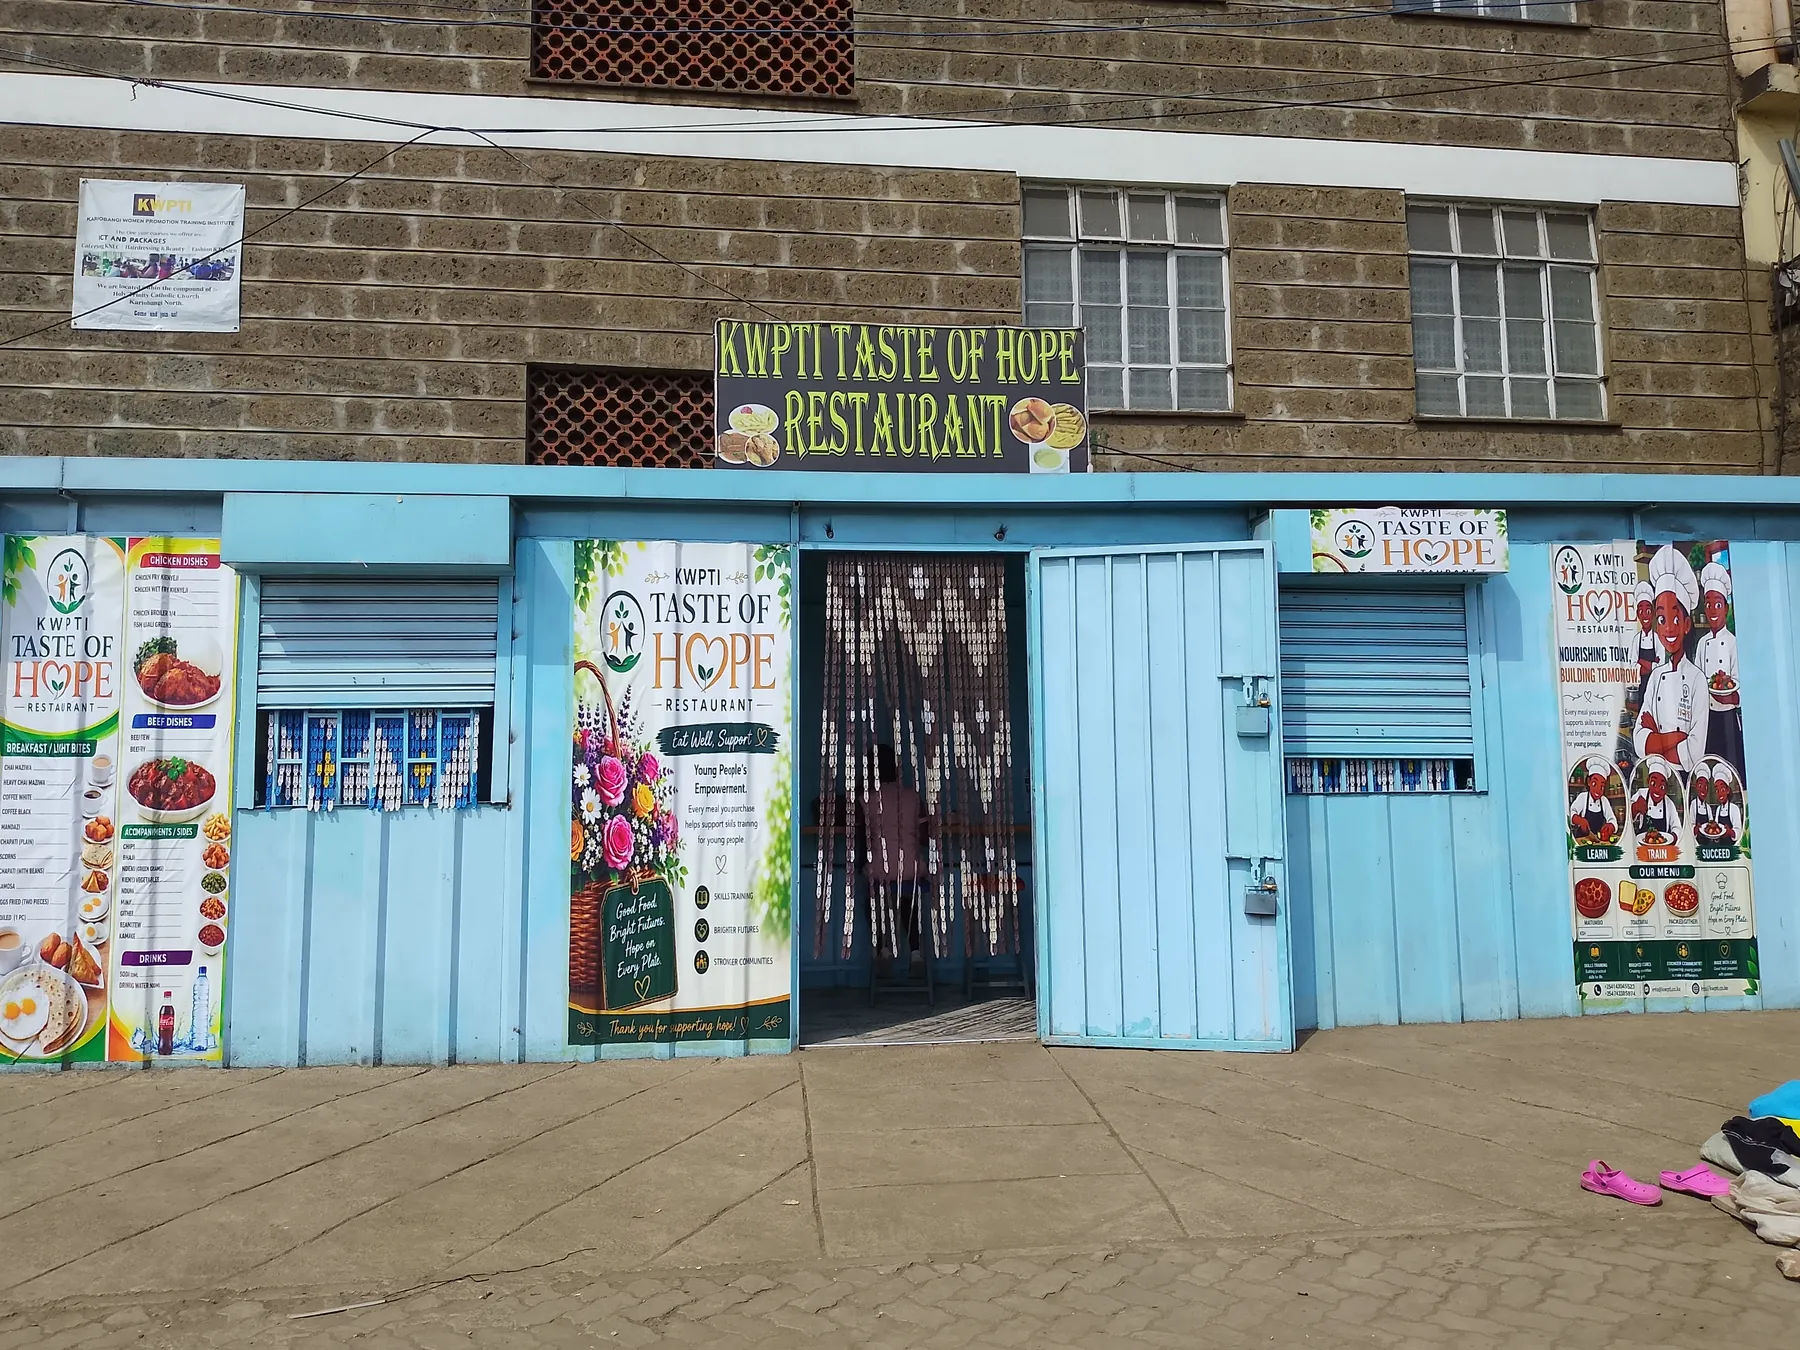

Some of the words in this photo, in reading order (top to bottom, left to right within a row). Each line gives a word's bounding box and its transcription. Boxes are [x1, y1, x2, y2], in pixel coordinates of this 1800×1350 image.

[138, 198, 192, 212] KWPTI
[719, 321, 823, 380] KWPTI
[829, 325, 940, 383] TASTE
[948, 327, 988, 384] OF
[995, 328, 1081, 385] HOPE
[784, 389, 1008, 462] RESTAURANT
[1400, 509, 1442, 518] KWPTI
[1378, 520, 1452, 536] TASTE
[1459, 520, 1489, 536] OF
[1382, 538, 1496, 566] HOPE
[150, 556, 182, 566] CHICKEN
[183, 557, 208, 566] DISHES
[1594, 554, 1624, 567] KWTI
[675, 567, 721, 586] KWPTI
[1620, 572, 1636, 586] OF
[649, 592, 732, 625] TASTE
[738, 592, 772, 625] OF
[36, 616, 88, 631] KWPTI
[1577, 624, 1625, 634] RESTAURAT
[12, 635, 76, 658] TASTE
[84, 635, 114, 658] OF
[652, 632, 776, 692] HOPE
[1559, 646, 1607, 662] NOURISHING
[1609, 646, 1632, 664] TOAY,
[1560, 667, 1596, 683] BUILDING
[27, 703, 95, 712] RESTAURANT
[666, 698, 753, 712] RESTAURANT
[148, 717, 165, 726] BEEF
[166, 717, 193, 726] DISHES
[672, 730, 690, 748] Eat
[690, 730, 715, 748] Well,
[718, 728, 752, 752] Support
[6, 743, 47, 754] BREAKFAST
[54, 743, 70, 754] LIGHT
[71, 743, 91, 754] BITES
[694, 764, 717, 778] Young
[719, 763, 748, 778] People's
[694, 782, 748, 798] Empowerment.
[688, 804, 704, 816] Every
[706, 804, 720, 812] meal
[176, 827, 193, 836] SIDES
[684, 820, 700, 830] helps
[702, 820, 724, 830] support
[697, 834, 706, 844] for
[706, 837, 725, 846] young
[726, 834, 744, 846] people
[1586, 849, 1608, 860] LEARN
[1647, 850, 1668, 860] TRAIN
[1702, 849, 1731, 859] SUCCEED
[1639, 868, 1655, 877] OUR
[1657, 868, 1680, 877] MENU
[714, 892, 730, 900] SKILLS
[616, 898, 636, 920] Good
[609, 920, 637, 944] Bright
[738, 926, 760, 934] FUTURES
[625, 938, 645, 958] Hope
[646, 937, 656, 949] on
[139, 954, 167, 964] DRINKS
[617, 960, 640, 979] Every
[609, 1019, 637, 1037] Thank
[638, 1024, 654, 1041] you
[654, 1018, 668, 1040] for
[670, 1016, 714, 1038] supporting
[715, 1016, 738, 1036] hope!
